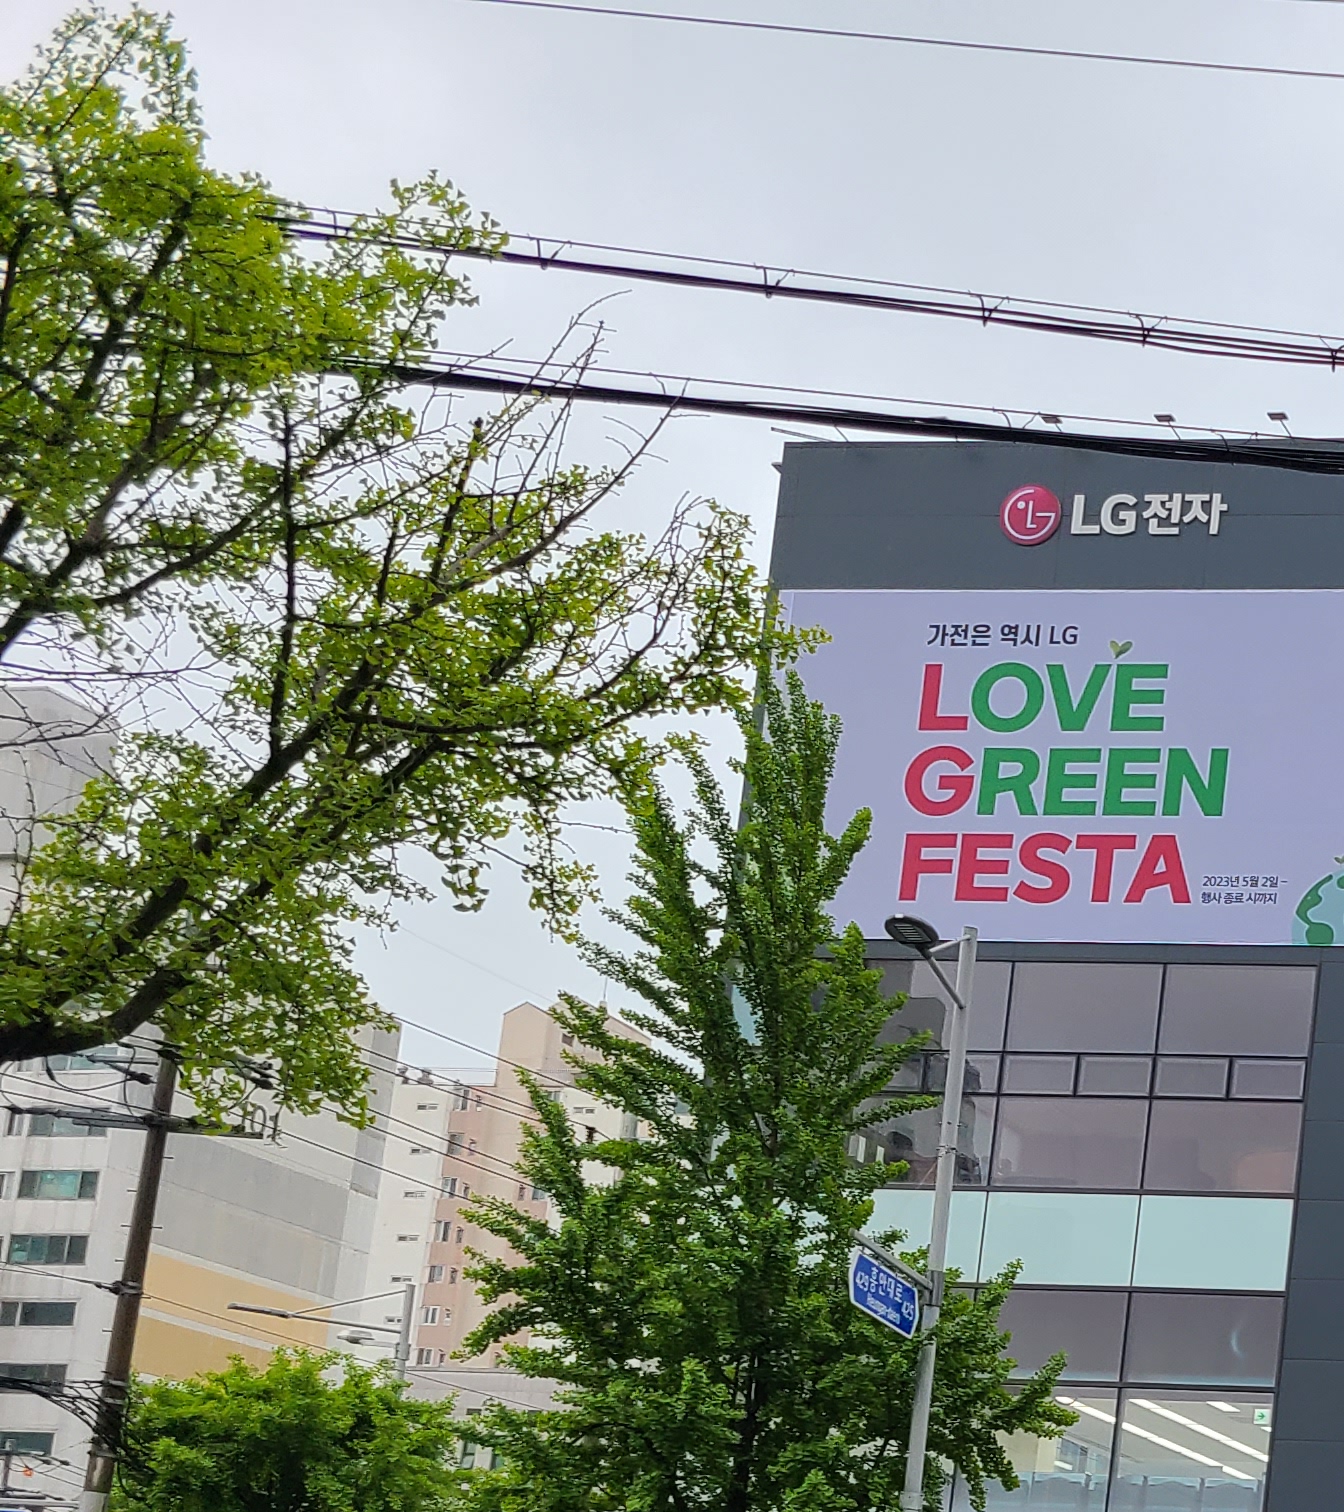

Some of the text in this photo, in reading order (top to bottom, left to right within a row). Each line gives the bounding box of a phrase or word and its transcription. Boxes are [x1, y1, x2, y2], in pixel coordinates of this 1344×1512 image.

[1070, 491, 1228, 538] LG전자
[926, 621, 1079, 649] 가전은 역시 LG
[917, 660, 1169, 733] LOVE
[902, 744, 1230, 818] GREEN
[898, 830, 1192, 904] FESTA
[1202, 875, 1240, 888] 2023년
[1241, 875, 1260, 888] 5월
[1261, 875, 1279, 888] 2일
[1201, 891, 1278, 905] 행사 종료 시까지
[869, 1266, 903, 1303] 흥안대로
